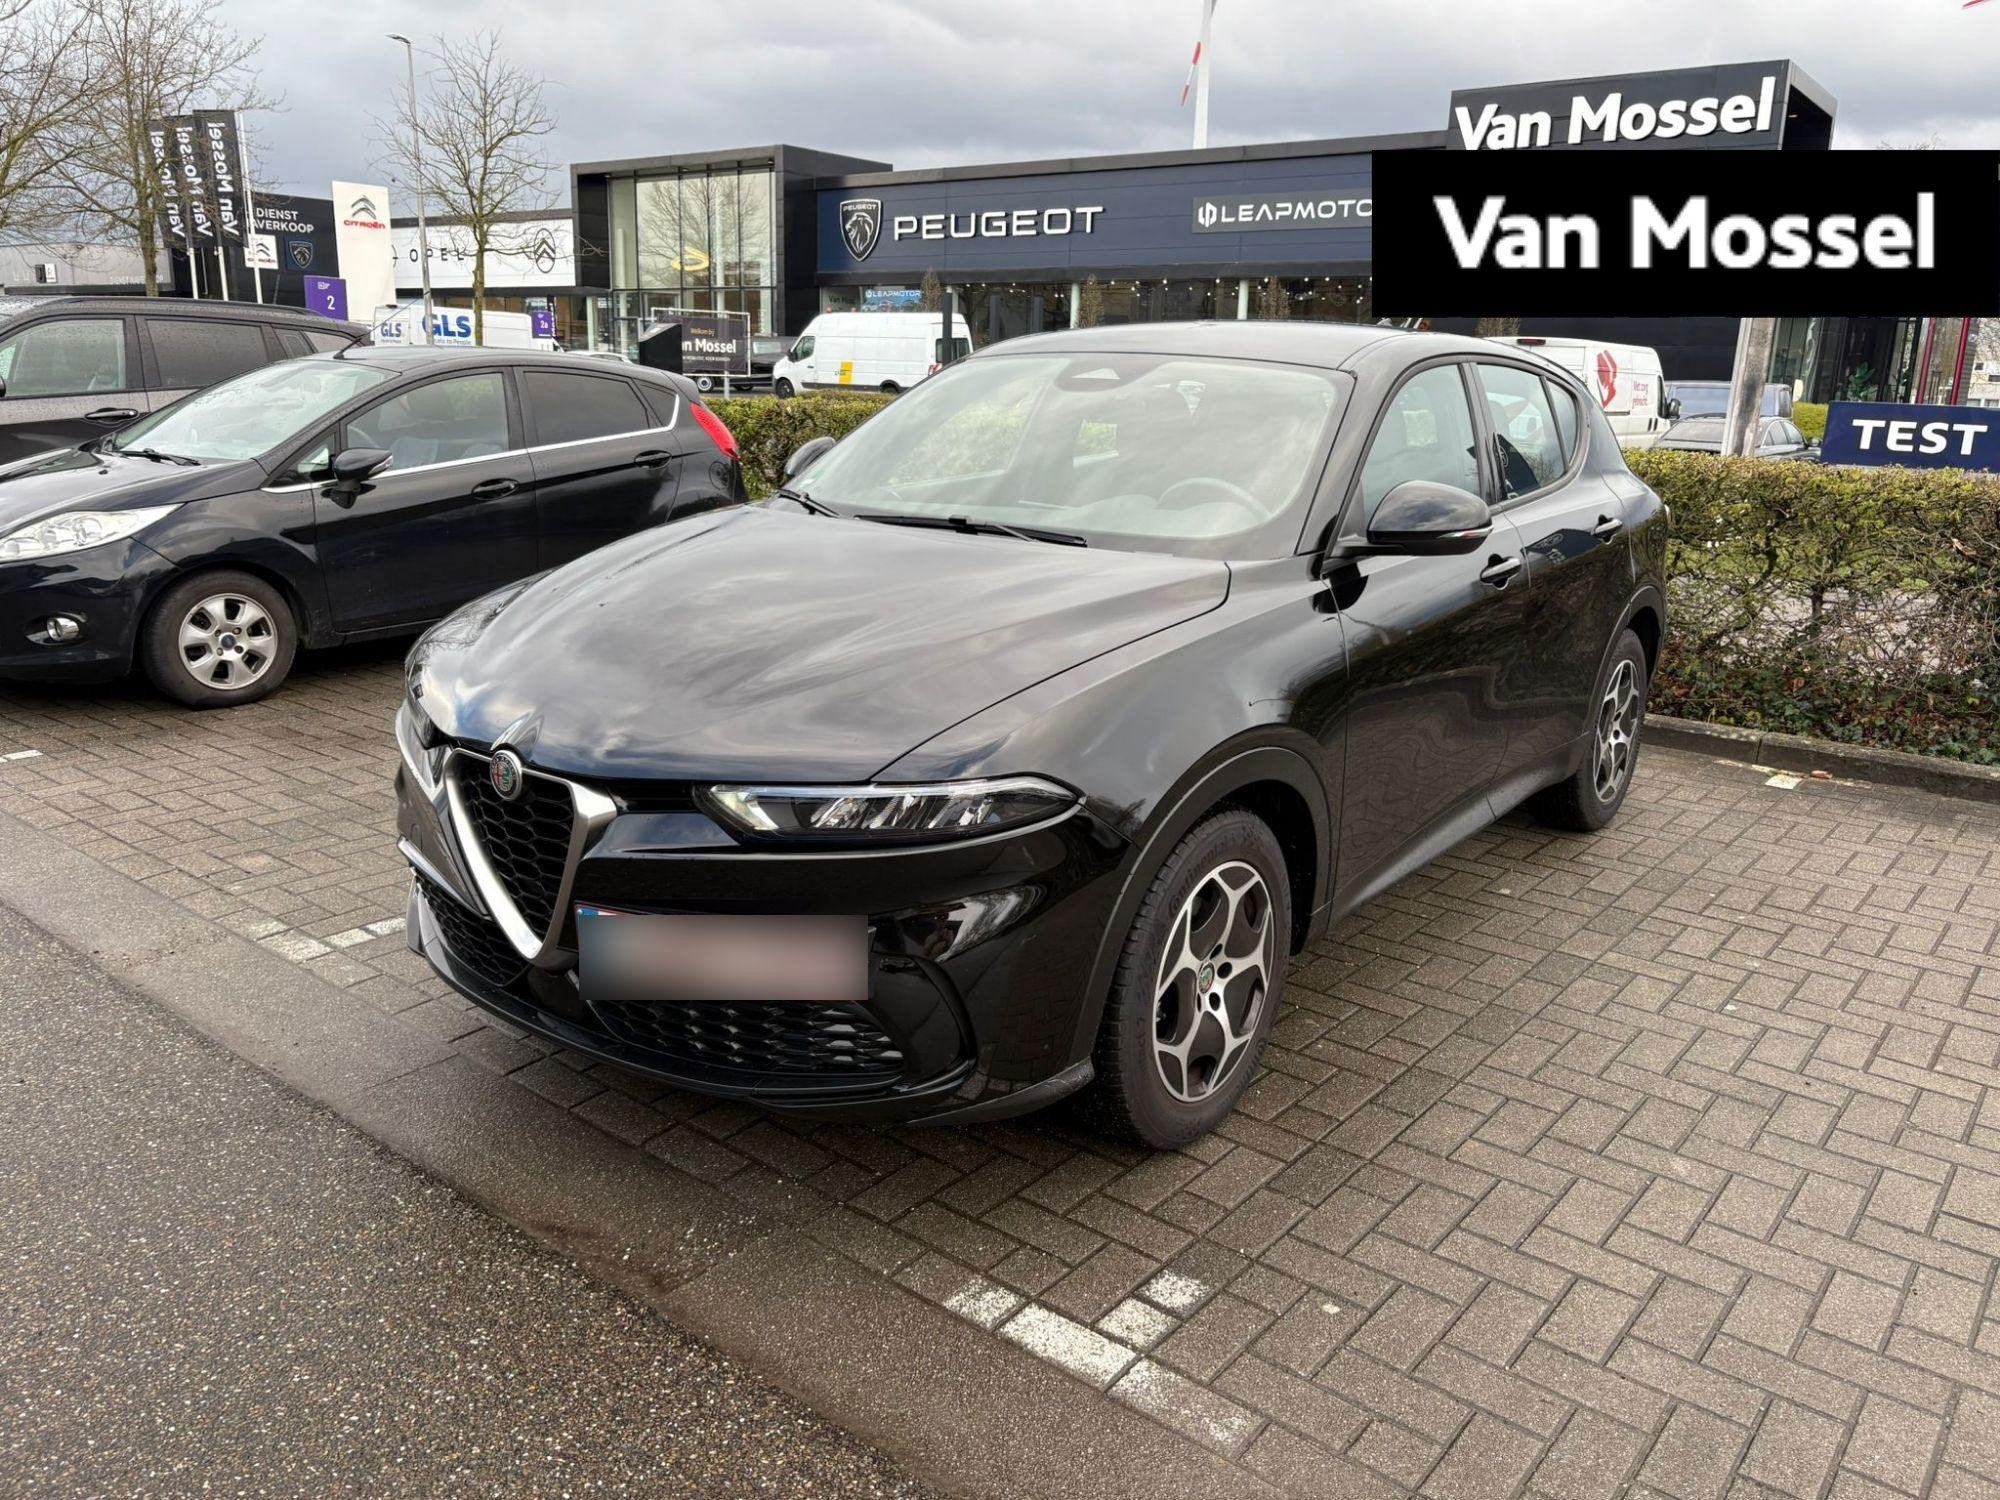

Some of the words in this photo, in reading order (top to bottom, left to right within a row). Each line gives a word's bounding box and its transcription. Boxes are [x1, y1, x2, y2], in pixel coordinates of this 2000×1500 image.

[1455, 103, 1551, 150] Van
[1568, 76, 1777, 145] Mossel
[256, 207, 298, 220] DIENST
[894, 206, 1104, 241] PEUGEOT
[327, 295, 336, 310] 2
[381, 322, 402, 338] GLS
[421, 314, 472, 338] GLS
[695, 338, 737, 354] Mossel
[1852, 418, 1988, 455] TEST
